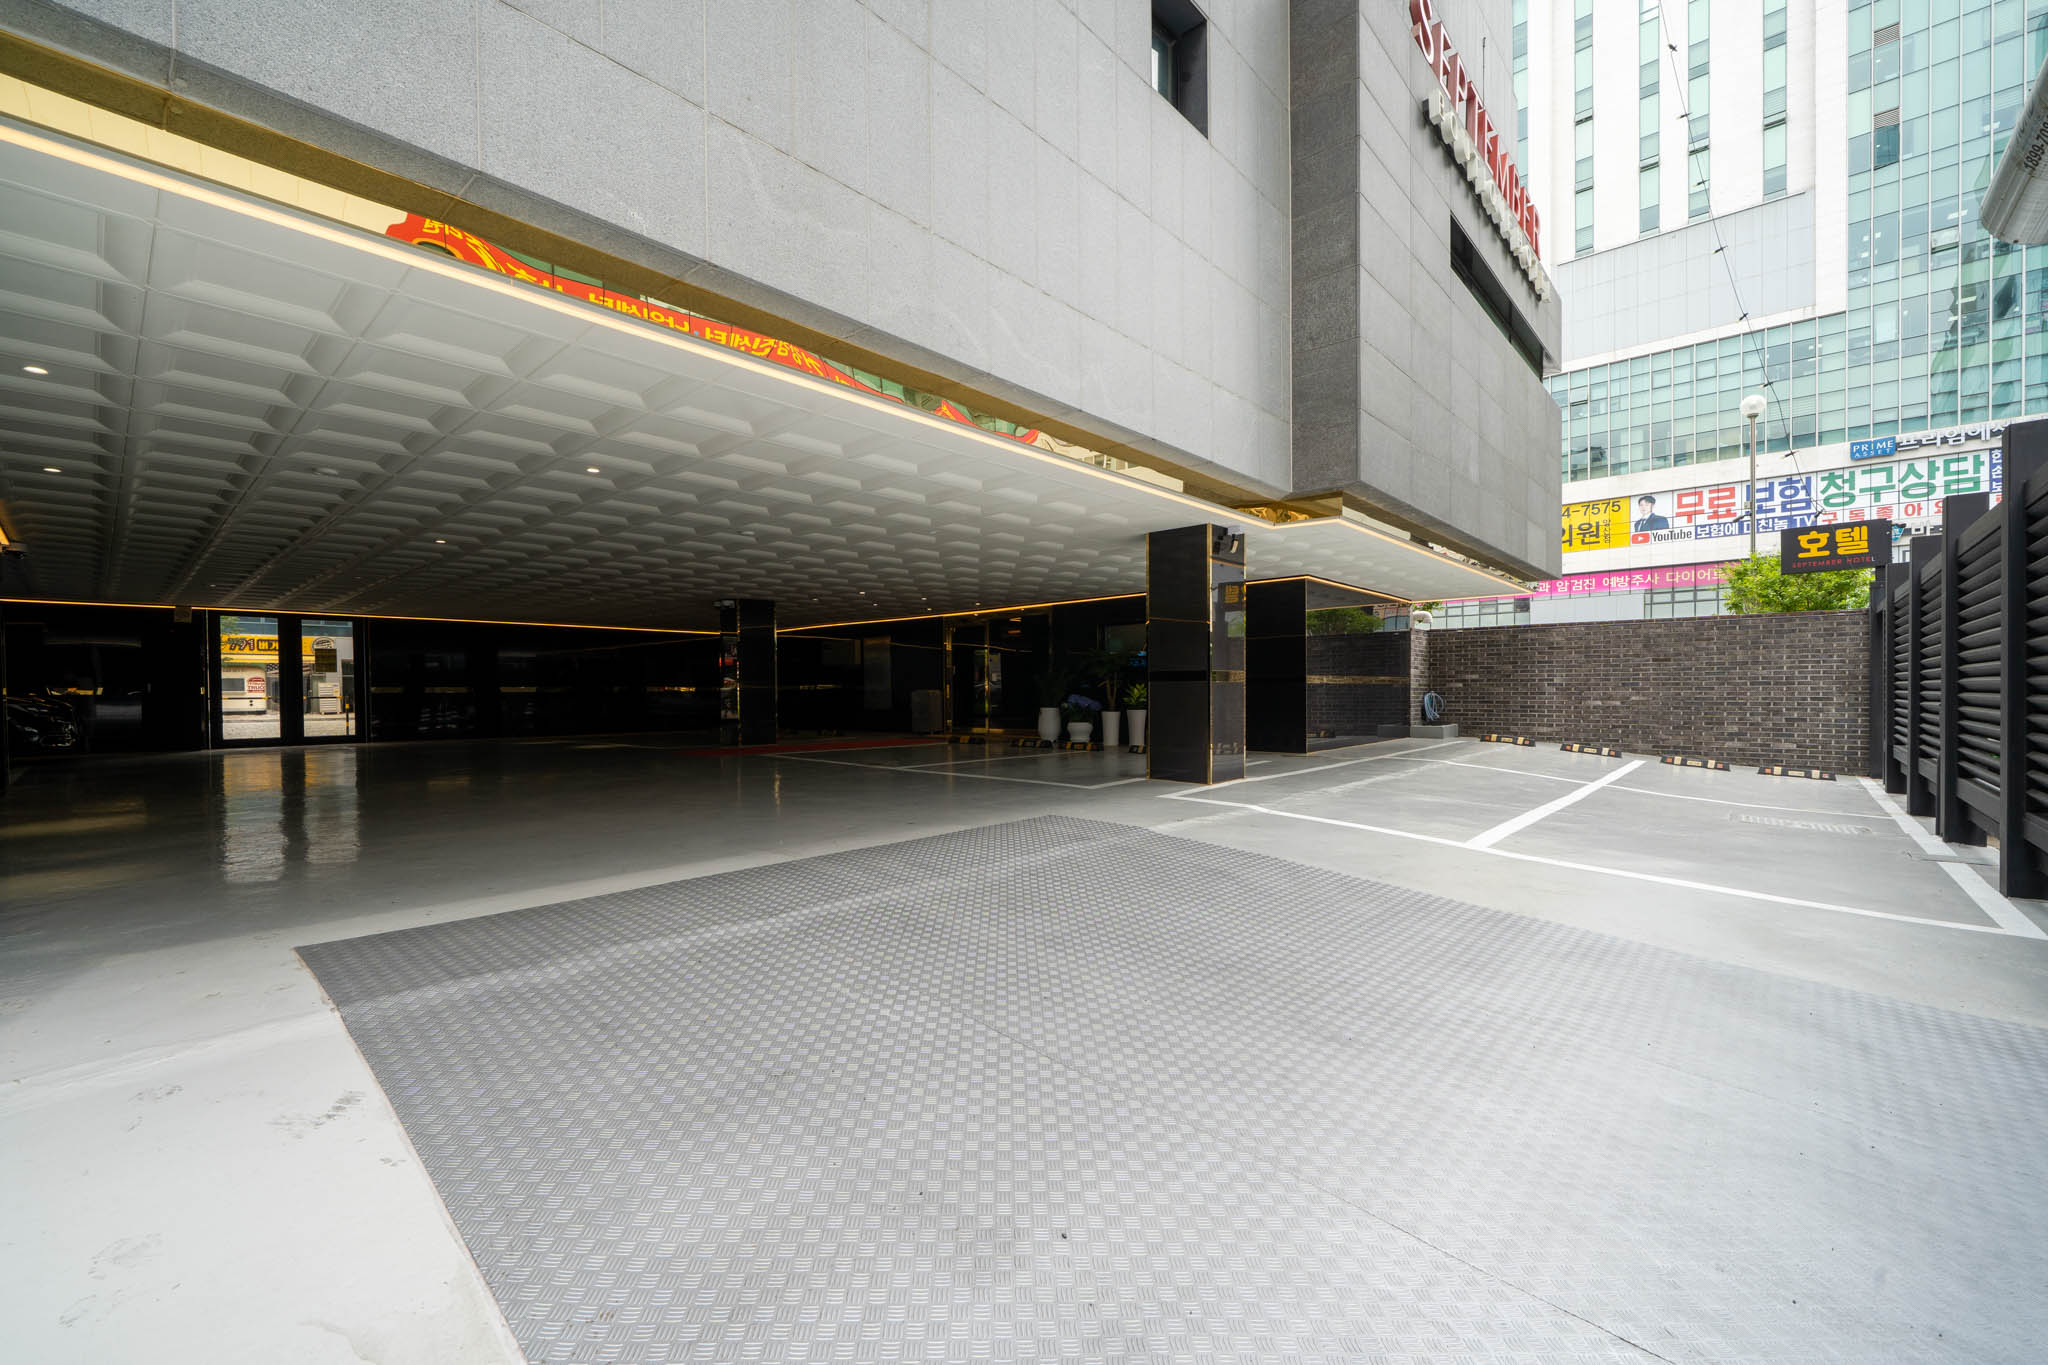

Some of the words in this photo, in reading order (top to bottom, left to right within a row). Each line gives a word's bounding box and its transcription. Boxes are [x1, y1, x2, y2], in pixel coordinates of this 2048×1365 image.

[1409, 0, 1541, 261] SEPTEMBER
[1853, 439, 1894, 452] PRIME
[1854, 448, 1891, 458] ASSET
[1675, 486, 1737, 524] 무료
[1820, 454, 1985, 508] 청구상담
[1793, 514, 1813, 528] TV
[1652, 529, 1692, 542] YouTube
[1797, 525, 1869, 558] 호텔
[1792, 558, 1842, 568] SEPTEMBER
[1846, 555, 1875, 564] HOTEL
[1602, 573, 1659, 588] 예방주사
